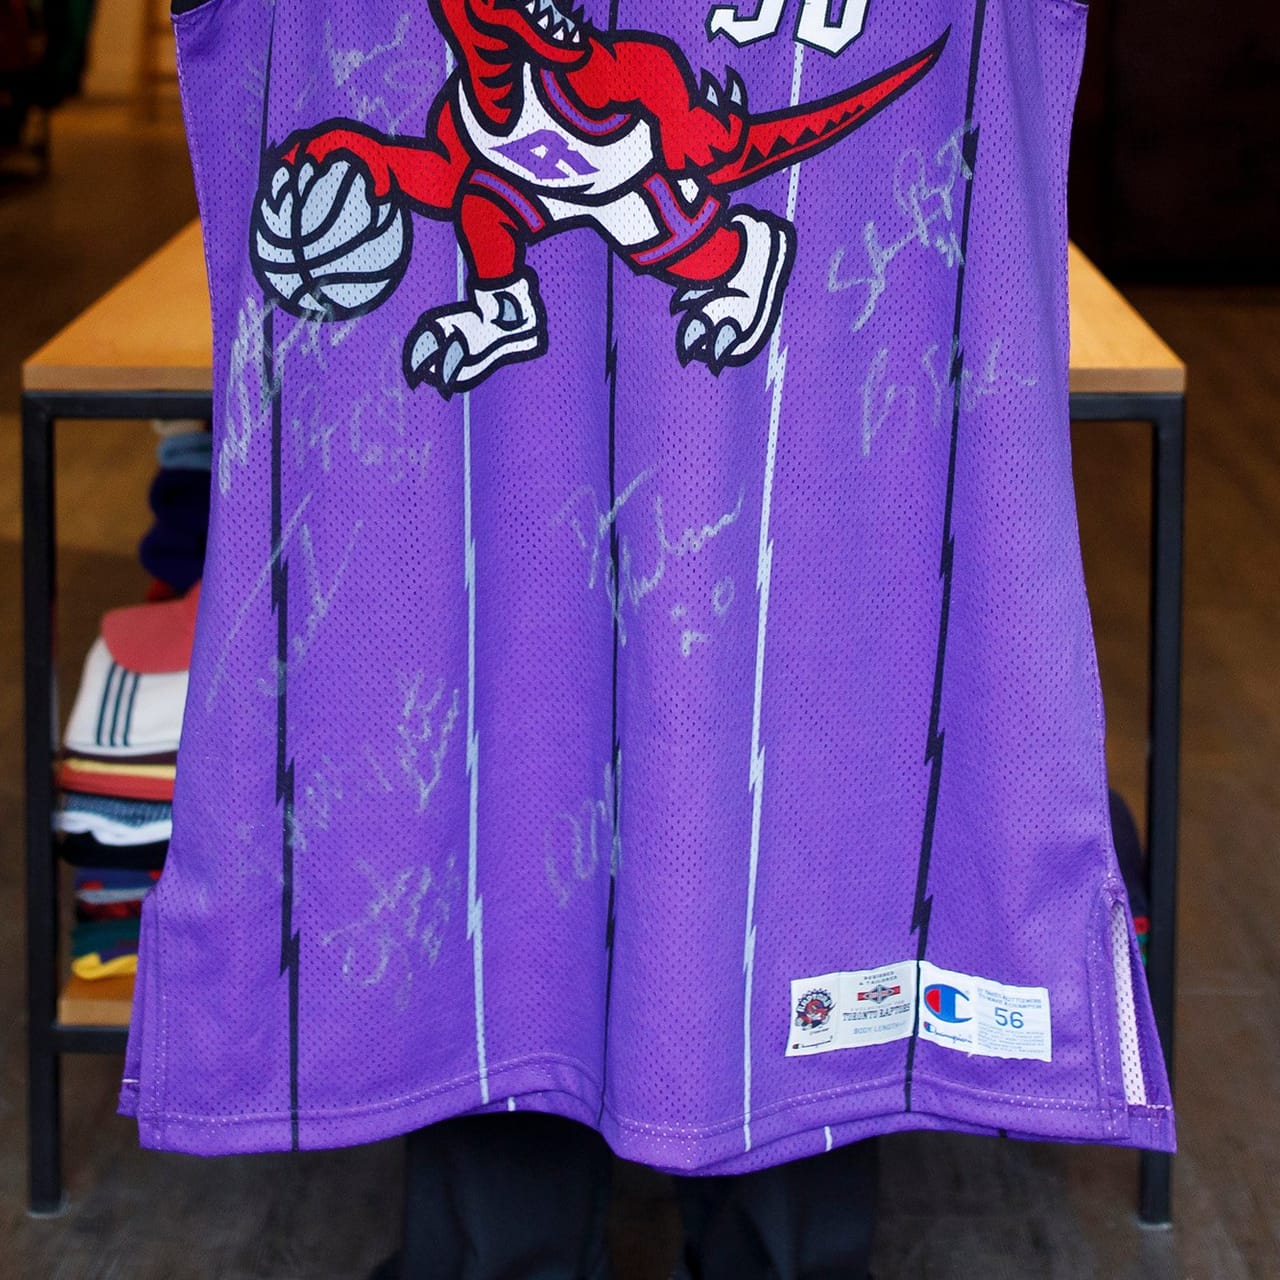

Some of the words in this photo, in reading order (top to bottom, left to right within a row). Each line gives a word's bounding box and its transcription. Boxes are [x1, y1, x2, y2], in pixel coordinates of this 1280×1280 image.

[842, 1009, 878, 1022] TORONTO
[879, 1003, 911, 1019] RAPTORS
[994, 1006, 1025, 1029] 56
